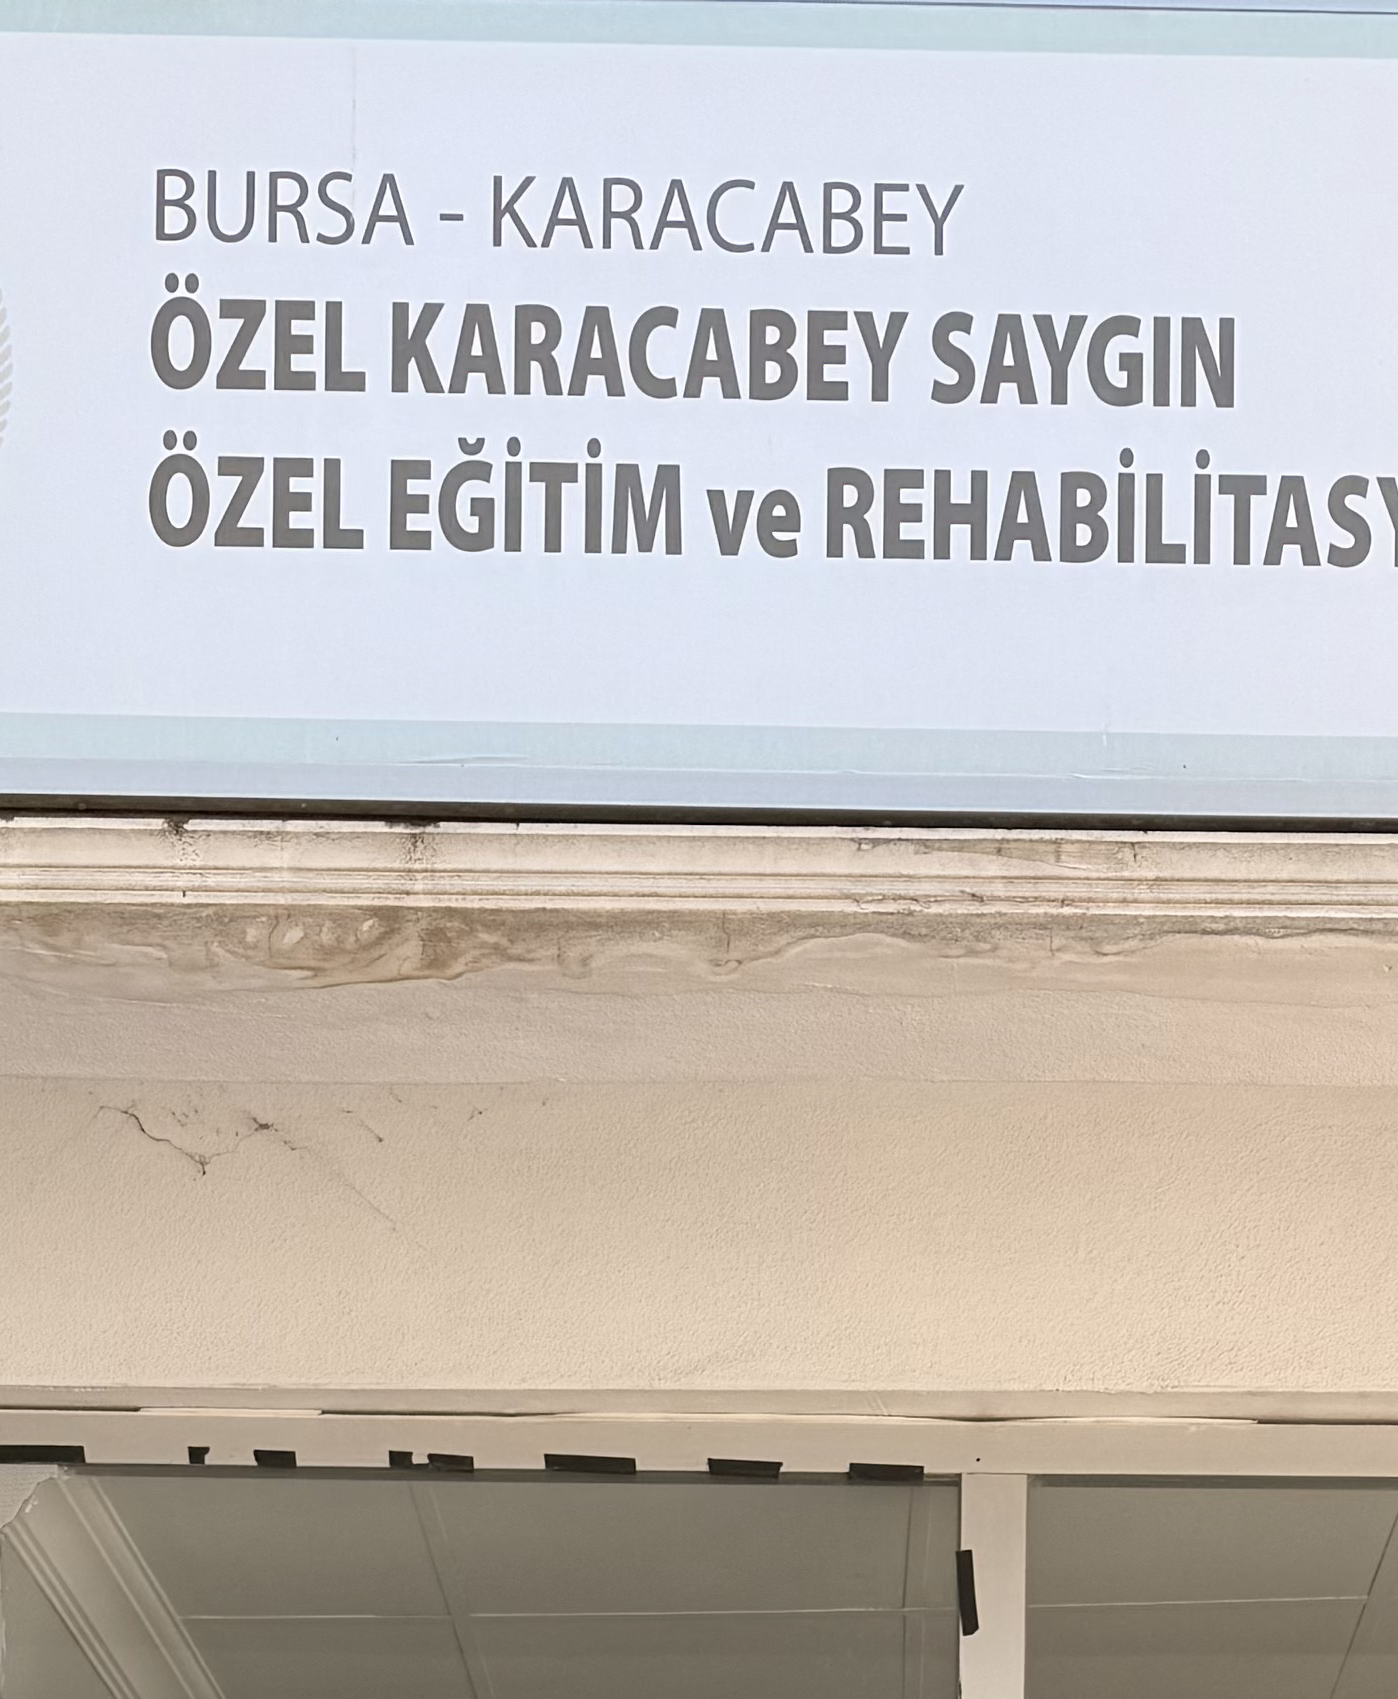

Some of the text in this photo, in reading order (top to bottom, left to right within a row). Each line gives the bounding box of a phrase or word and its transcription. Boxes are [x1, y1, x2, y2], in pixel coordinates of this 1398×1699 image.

[155, 168, 414, 246] BURSA
[492, 175, 965, 256] KARACABEY
[150, 272, 1235, 409] ÖZEL KARACABEY SAYGIN
[148, 429, 365, 550] ÖZEL
[389, 436, 683, 556] EĞİTİM
[705, 486, 802, 559] ve
